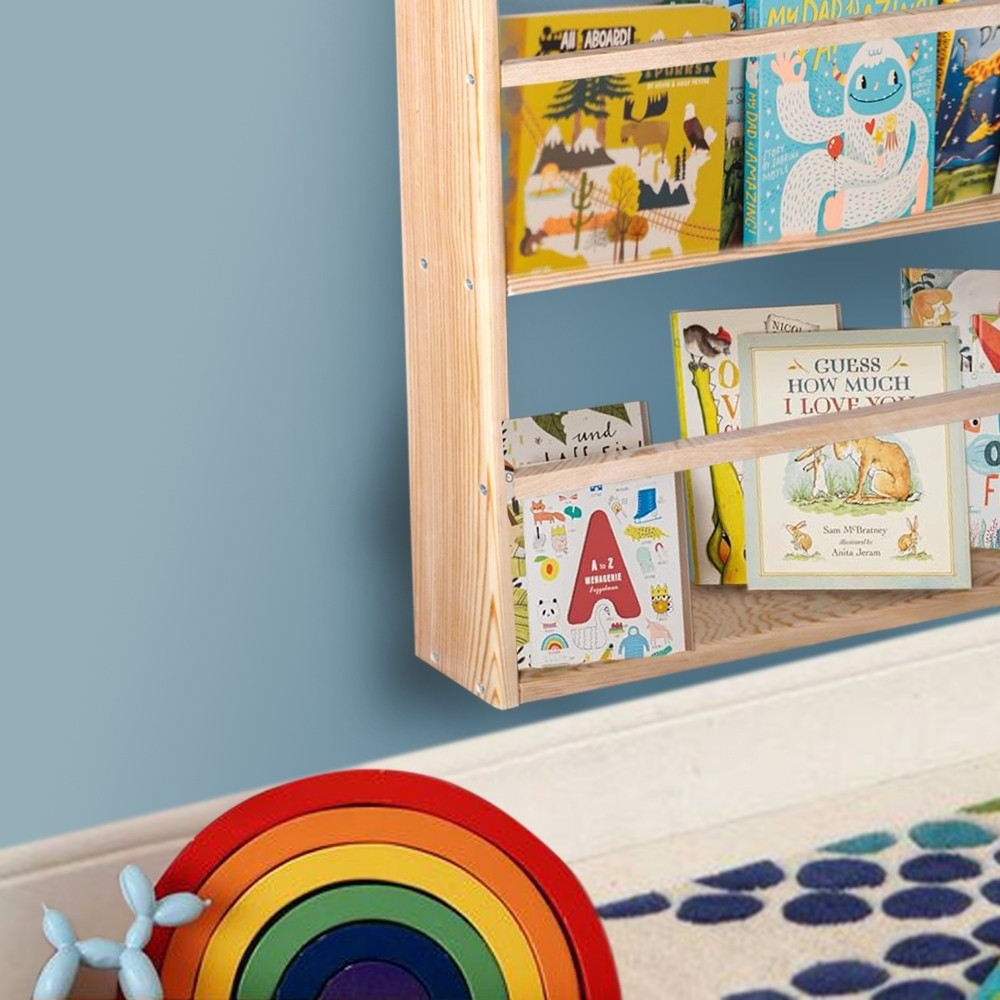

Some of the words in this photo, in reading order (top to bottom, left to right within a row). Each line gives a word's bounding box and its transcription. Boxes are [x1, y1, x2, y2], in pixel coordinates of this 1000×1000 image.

[584, 27, 632, 49] ABOARD!
[814, 357, 882, 374] GUESS
[787, 378, 838, 394] HOW
[844, 375, 910, 393] MUCH
[784, 398, 793, 415] I
[572, 421, 617, 443] und
[832, 548, 853, 557] Anita
[856, 548, 881, 557] Jeram
[591, 559, 598, 571] A
